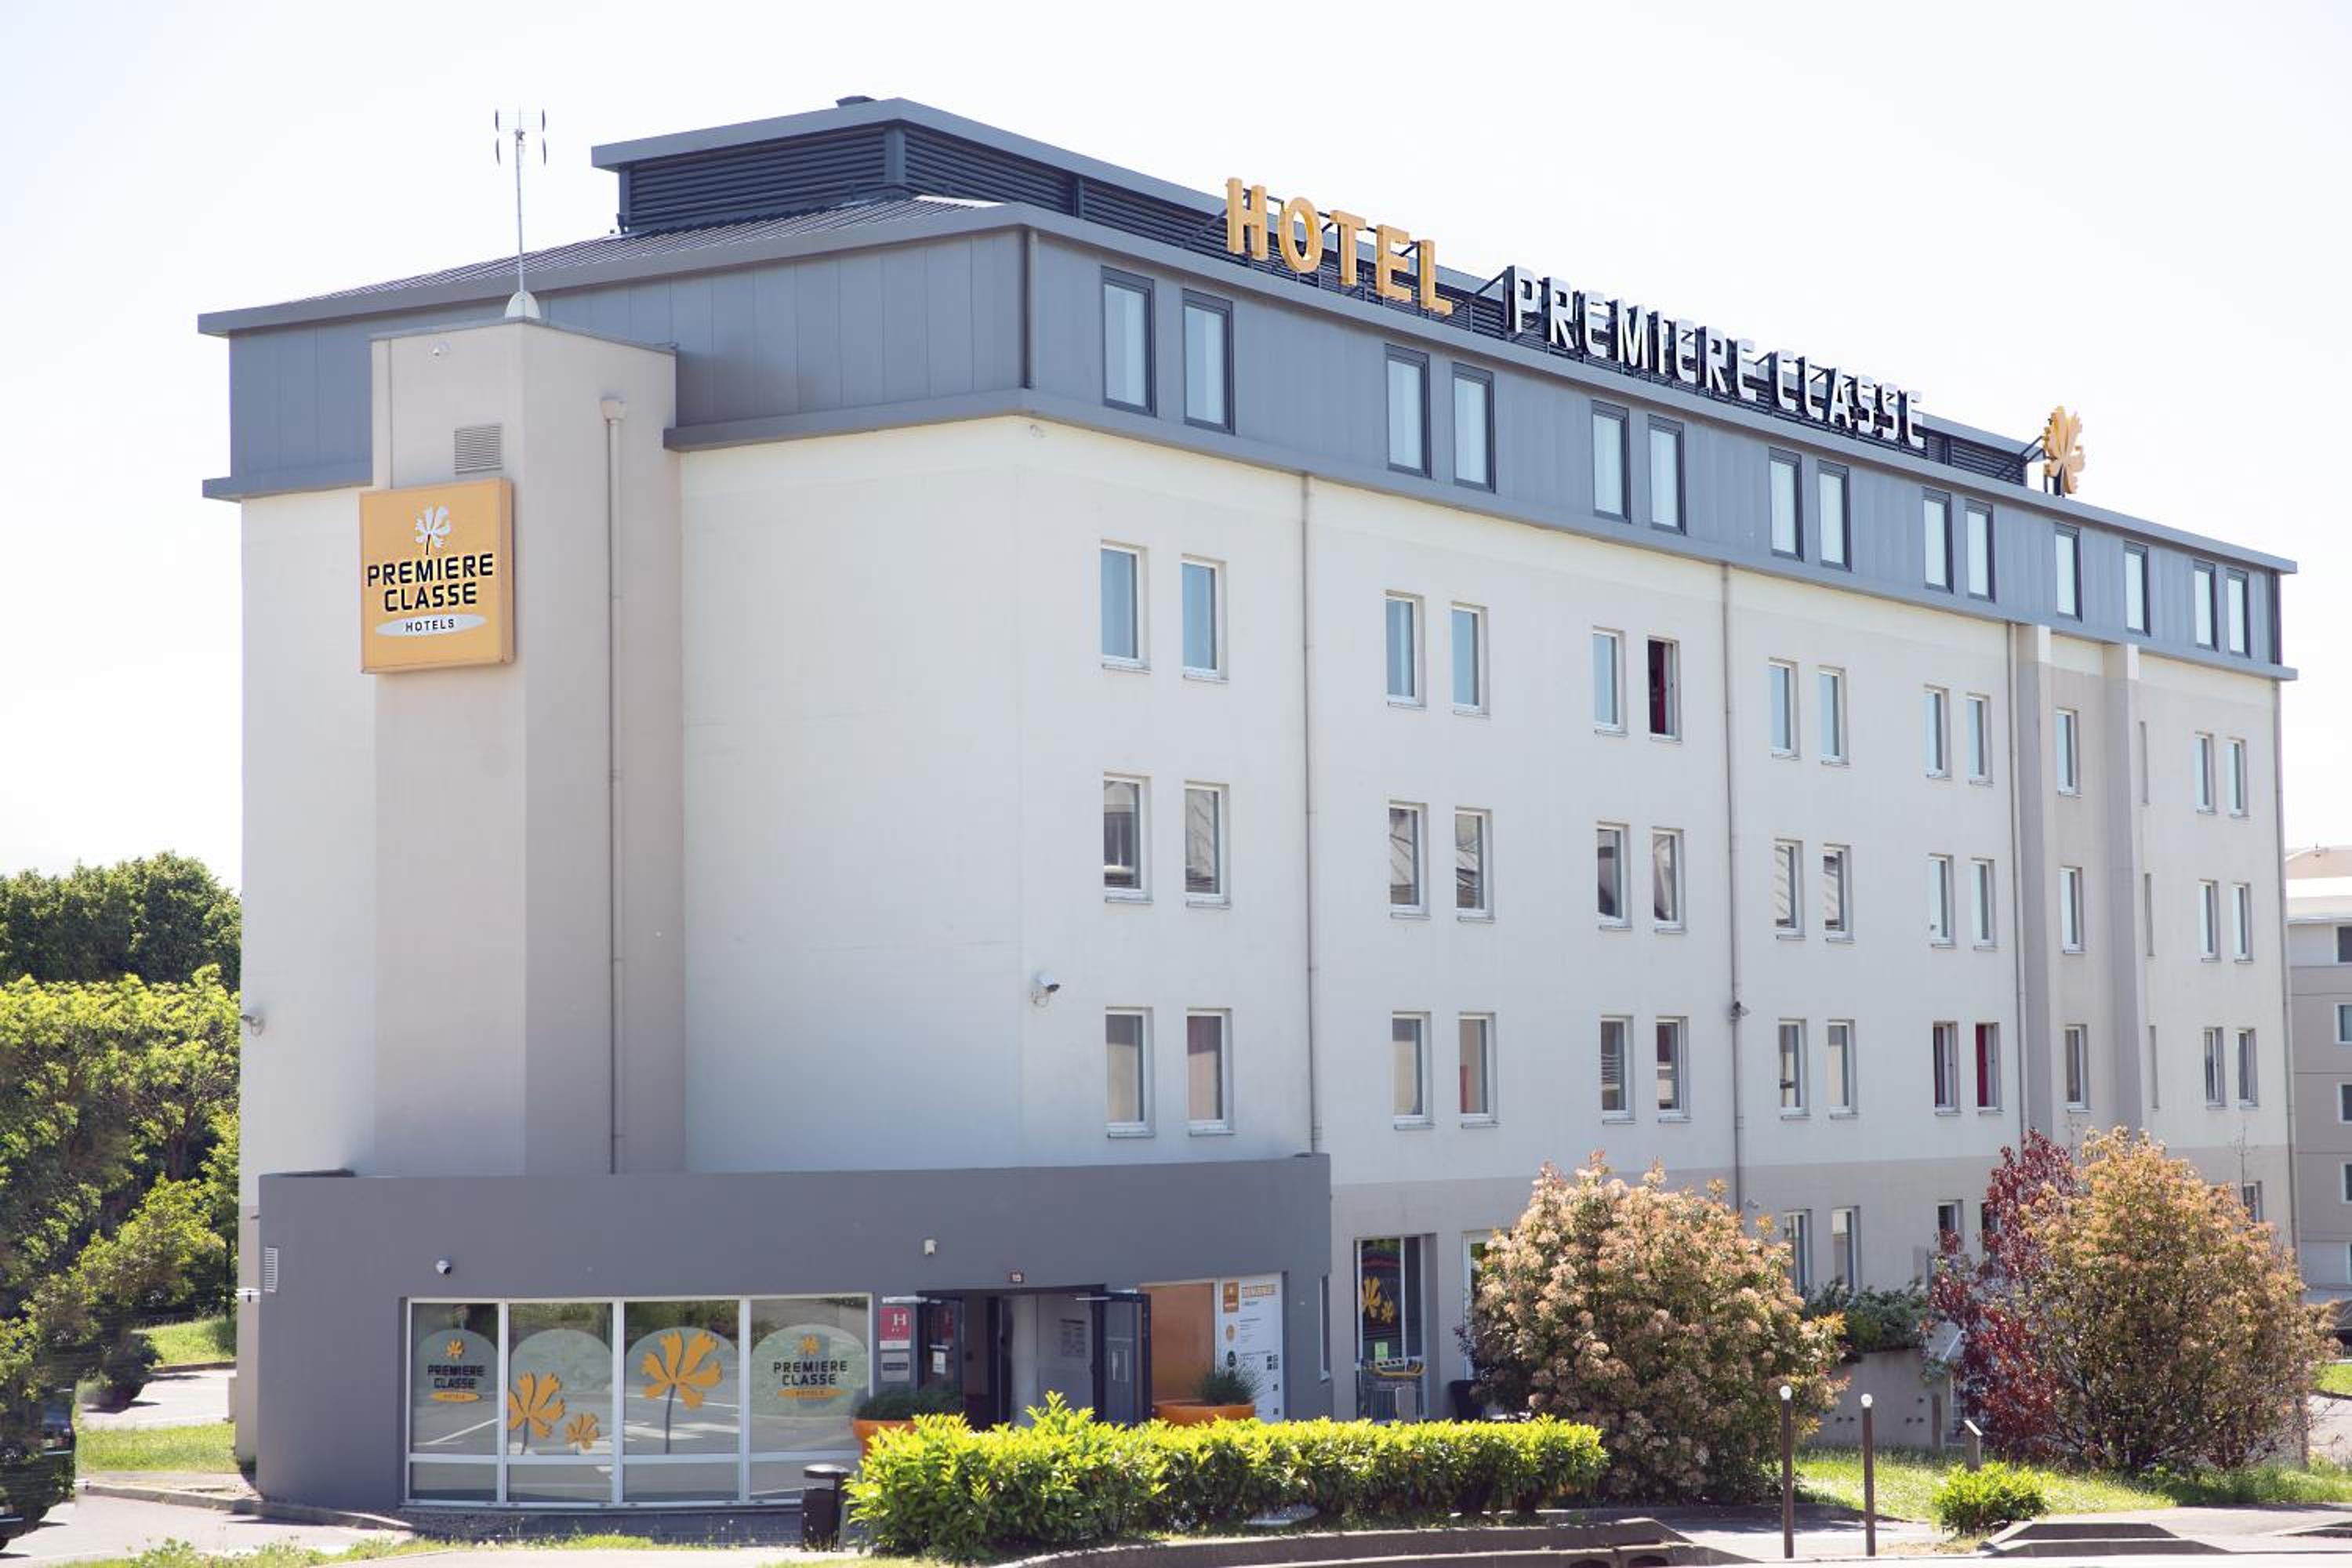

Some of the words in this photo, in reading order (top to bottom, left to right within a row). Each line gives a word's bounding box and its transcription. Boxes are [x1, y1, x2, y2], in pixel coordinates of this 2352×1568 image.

[1226, 177, 1452, 315] HOTEL
[1504, 265, 1757, 401] PREMIERE
[1769, 349, 1925, 449] CLASSE
[367, 553, 494, 586] PREMIERE
[384, 582, 477, 612] CLASSE
[405, 619, 455, 632] HOTELS
[773, 1361, 848, 1374] PREMIERE
[782, 1374, 837, 1385] CLASSE
